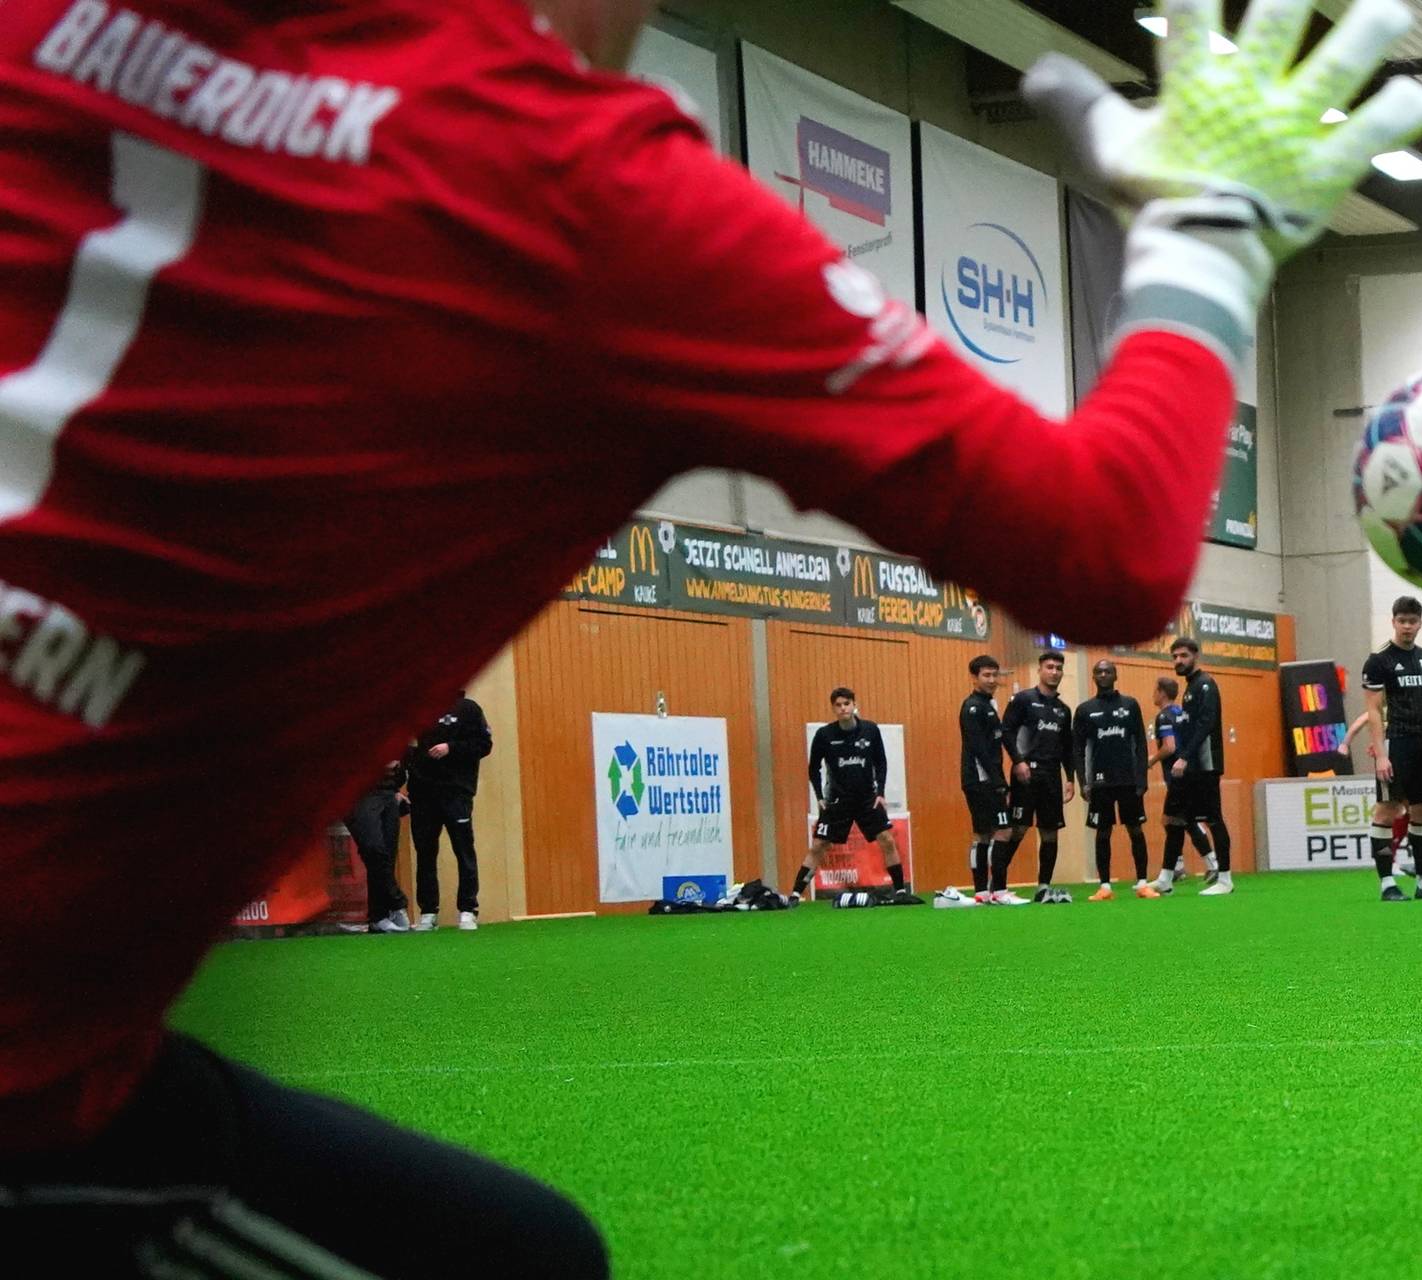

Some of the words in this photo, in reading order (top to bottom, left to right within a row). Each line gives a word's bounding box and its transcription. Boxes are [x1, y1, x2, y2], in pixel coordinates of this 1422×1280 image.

[33, 2, 400, 166] BAUERDICK
[807, 140, 885, 195] HAMMEKE
[684, 538, 721, 568] JETZT
[723, 544, 774, 576] SCHNELL
[775, 551, 831, 582] ANMELDEN
[879, 560, 939, 598] FUSSBALL
[878, 595, 944, 629] FERIEN-CAMP
[1298, 683, 1328, 713] NO
[1292, 722, 1348, 756] RACISM
[645, 745, 720, 778] Röhrtaler
[647, 783, 722, 816] Wertstoff
[816, 822, 829, 837] 21
